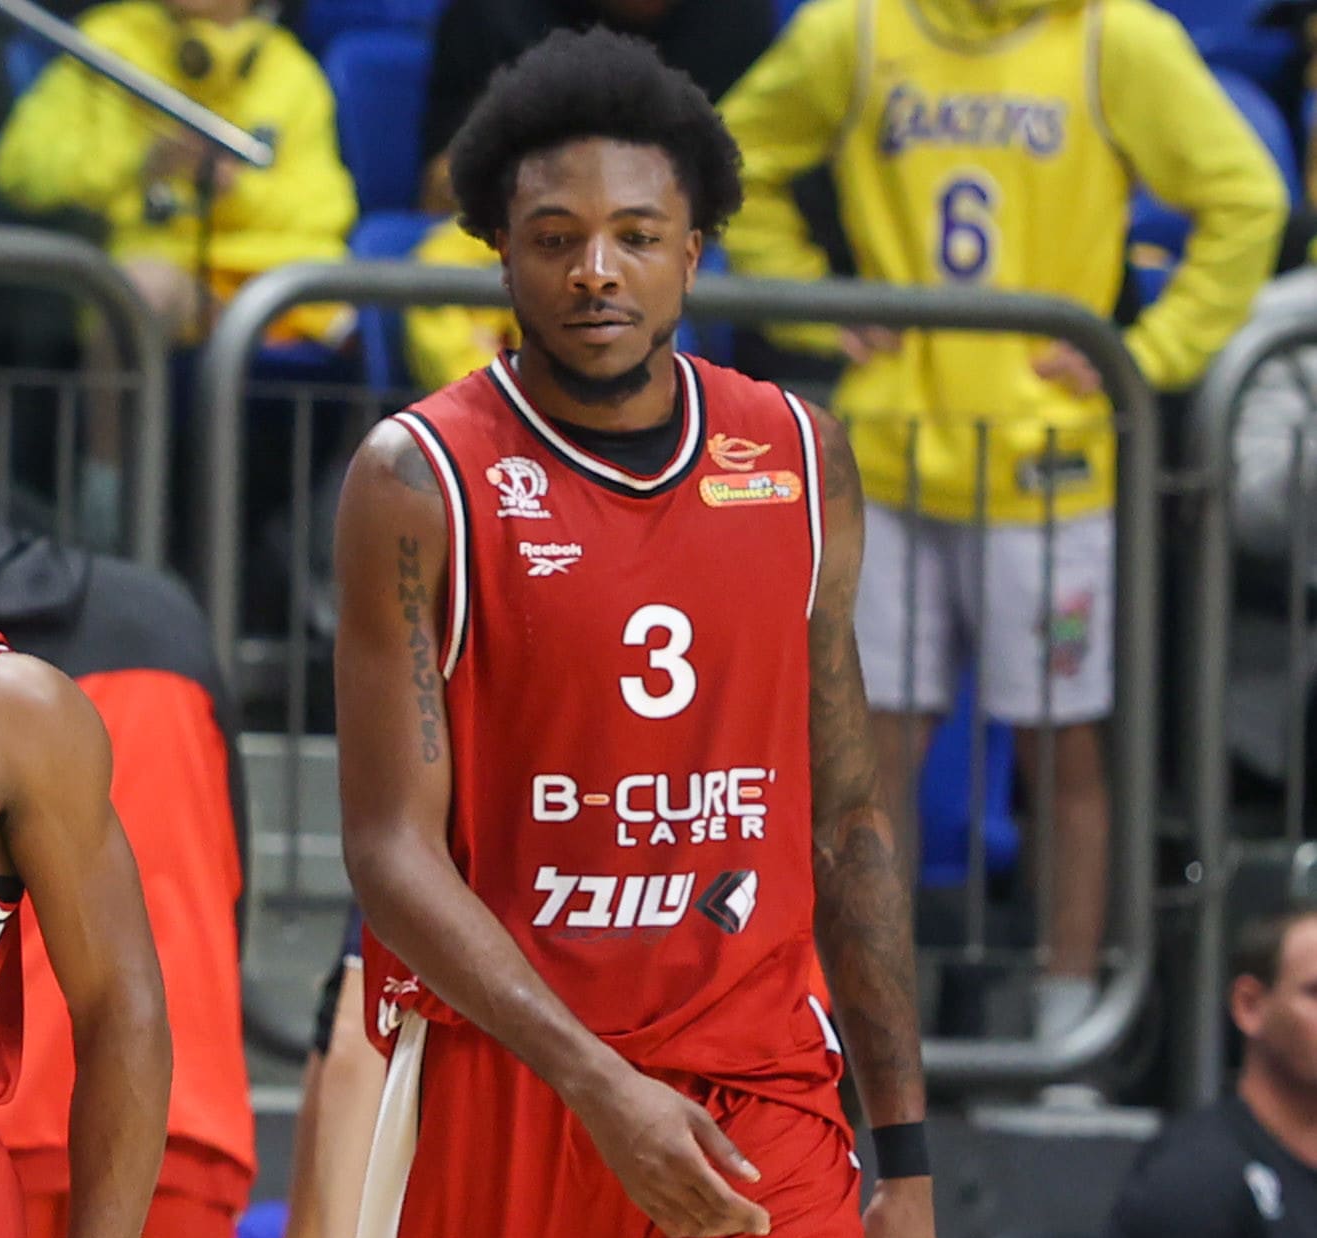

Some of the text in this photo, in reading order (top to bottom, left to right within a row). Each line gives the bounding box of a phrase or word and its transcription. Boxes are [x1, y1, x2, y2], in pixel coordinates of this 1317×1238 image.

[936, 172, 996, 281] 6
[519, 541, 582, 557] Reebok
[619, 603, 698, 719] 3
[617, 817, 765, 847] LASER
[532, 866, 695, 928] שובל
